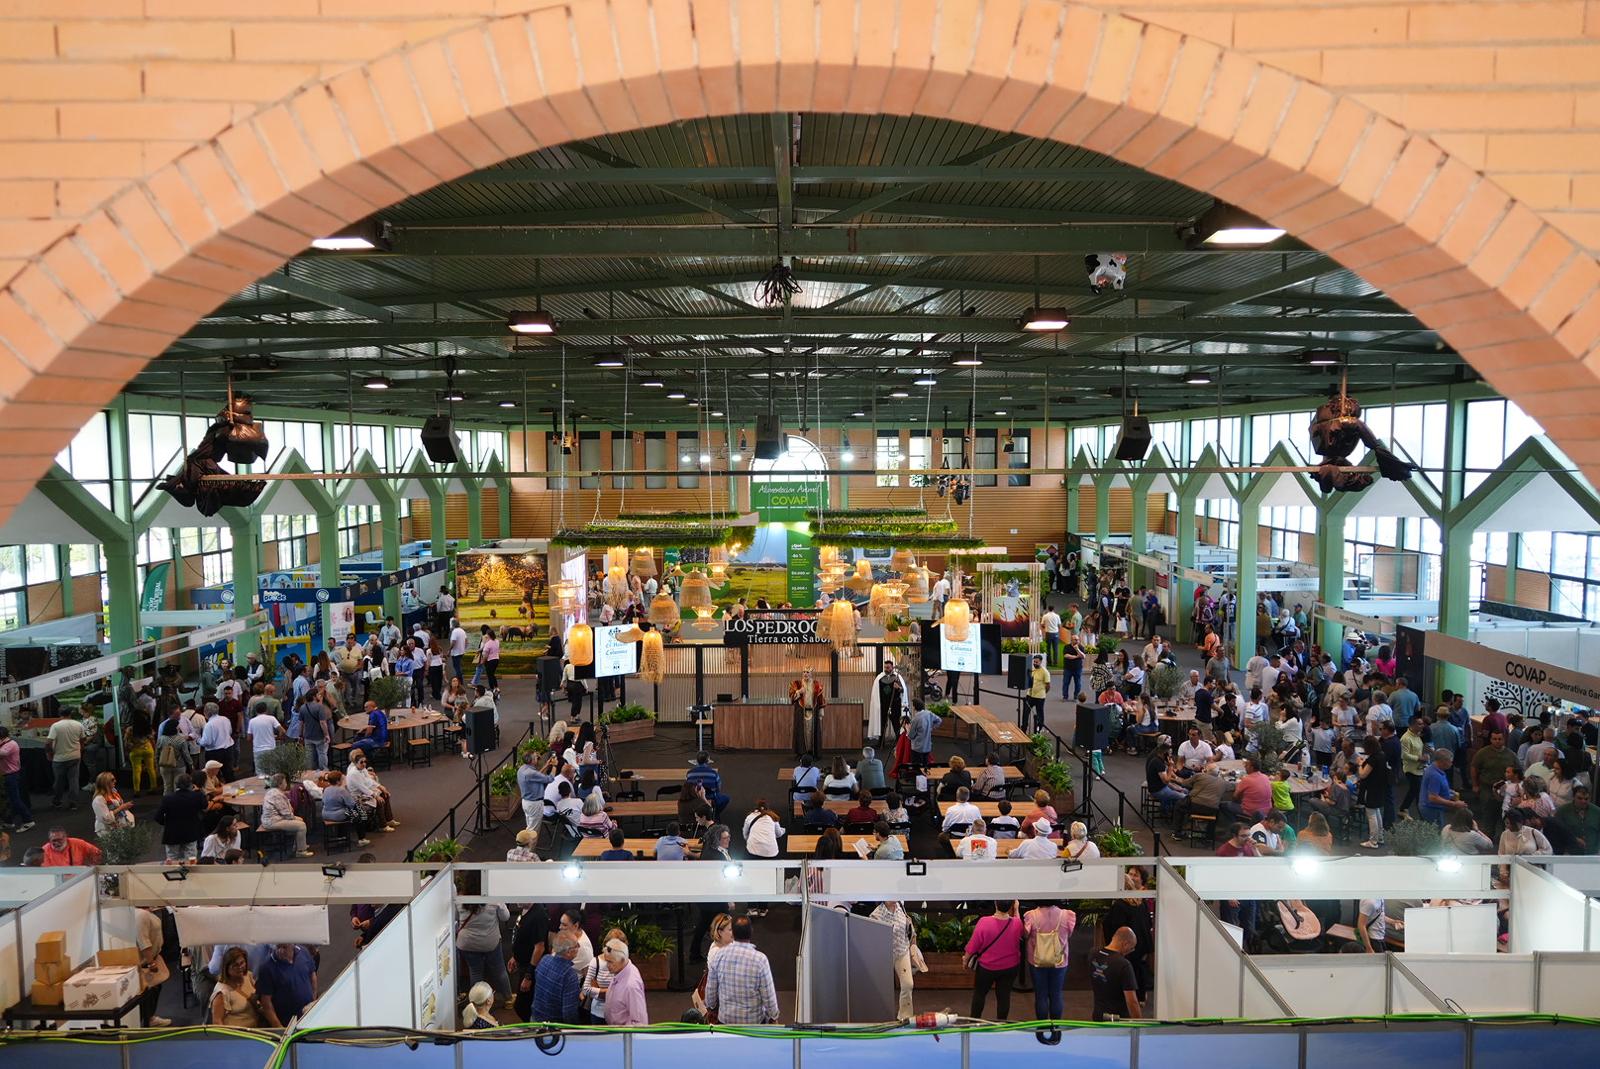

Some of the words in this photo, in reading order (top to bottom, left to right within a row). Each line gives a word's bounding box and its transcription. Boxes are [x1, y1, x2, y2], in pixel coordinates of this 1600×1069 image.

[771, 496, 808, 505] COVAP
[726, 619, 754, 632] LOS
[756, 620, 818, 634] PEDROC
[748, 635, 778, 643] Tierra
[1506, 661, 1546, 684] COVAP
[1548, 677, 1587, 696] Cooperativa
